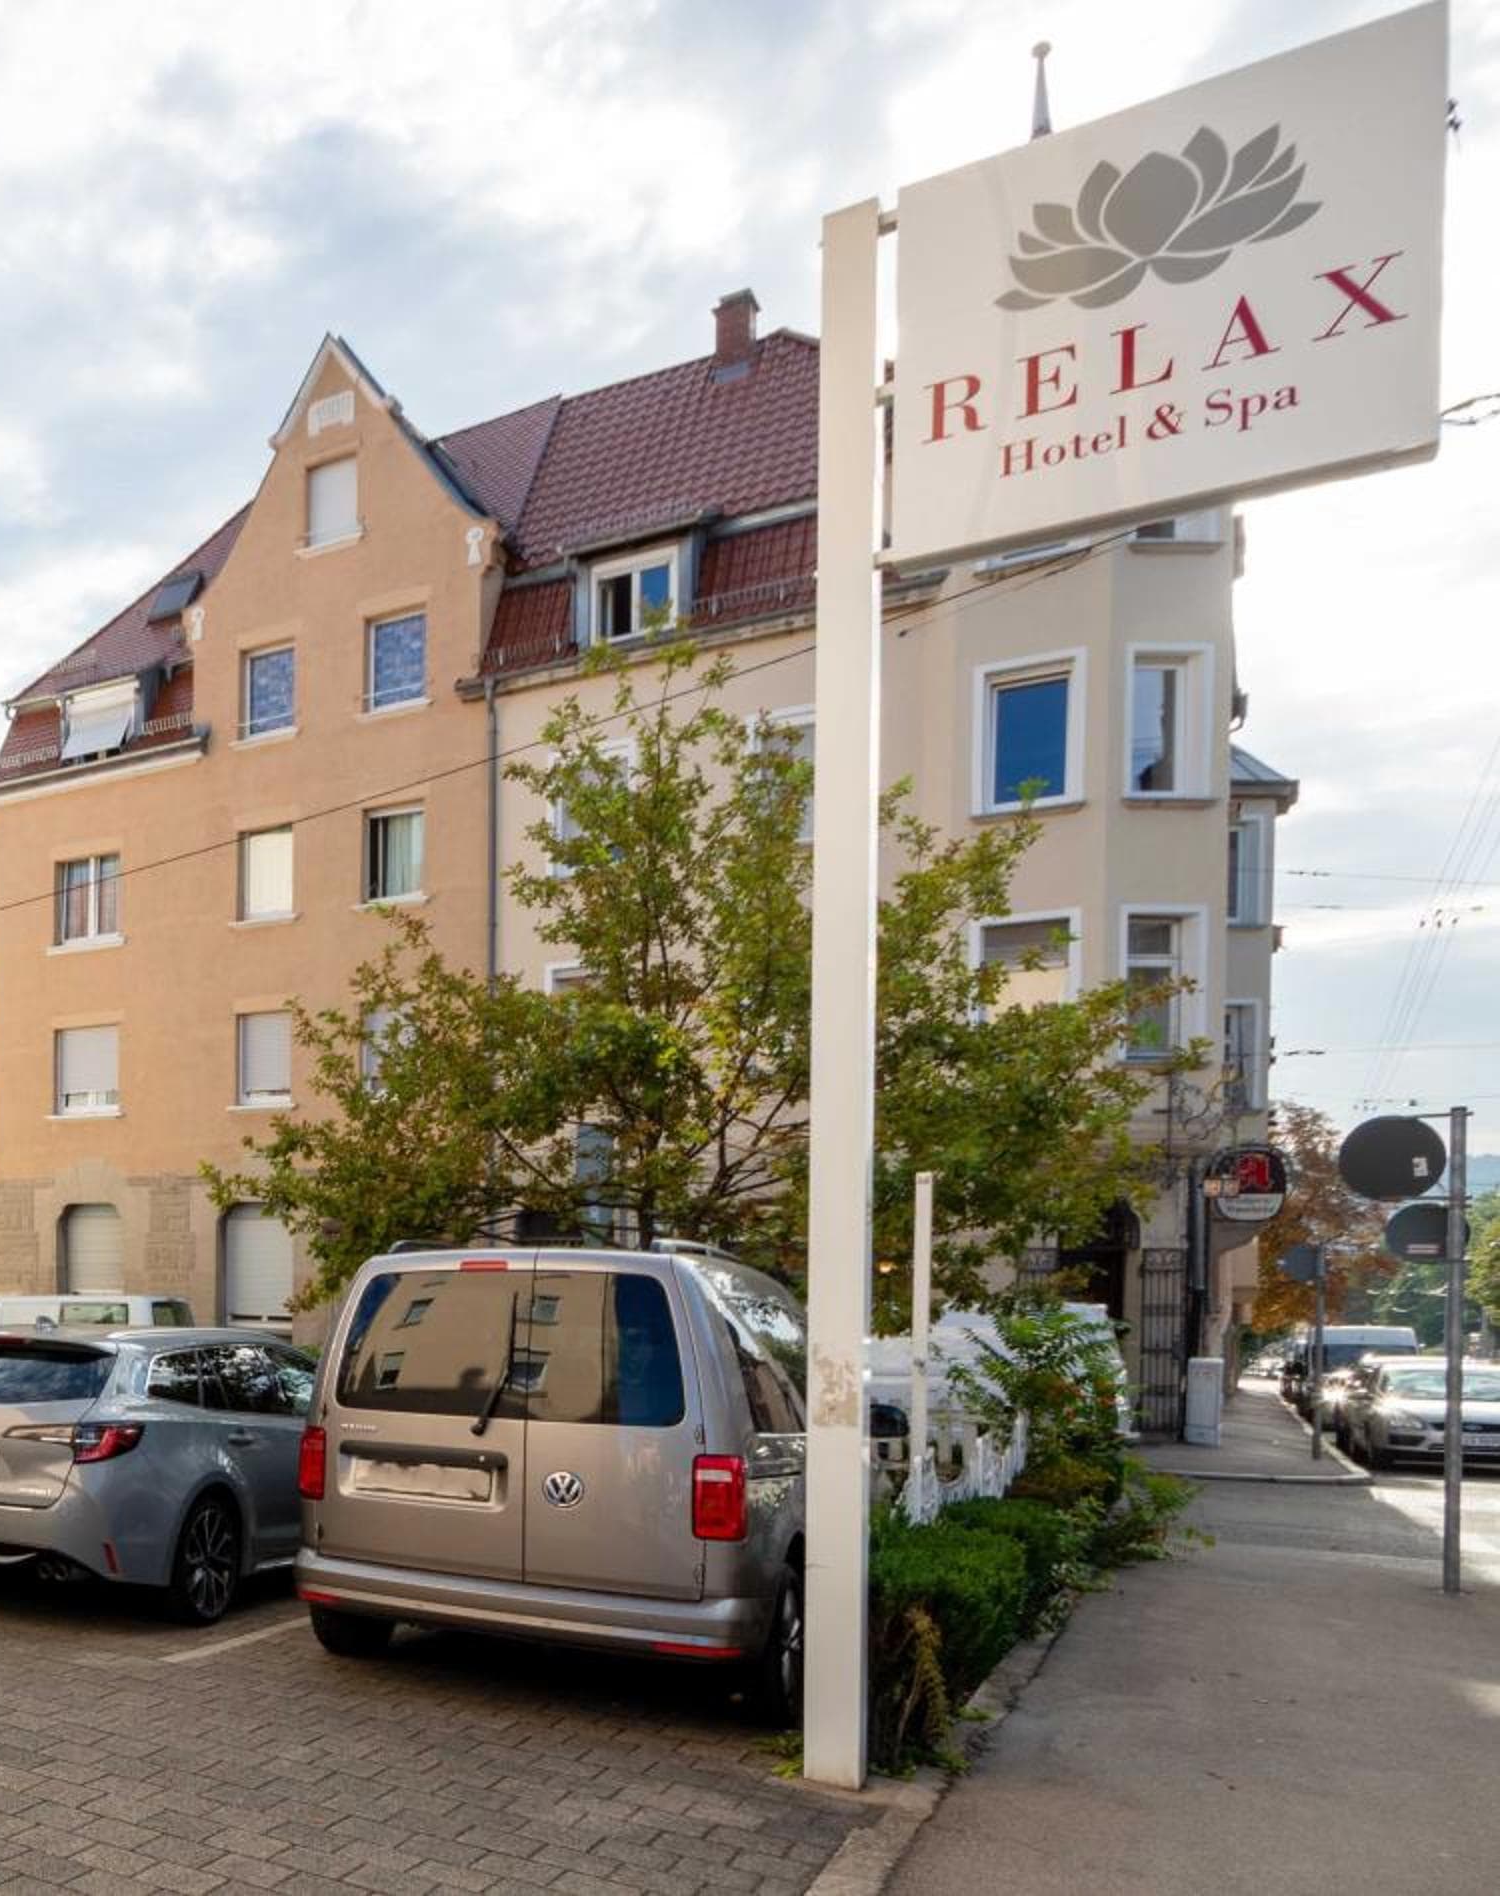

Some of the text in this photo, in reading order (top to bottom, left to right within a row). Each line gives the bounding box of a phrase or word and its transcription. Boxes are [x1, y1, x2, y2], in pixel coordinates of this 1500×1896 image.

[922, 250, 1409, 445] RELAX
[999, 384, 1301, 479] Hotel & Spa
